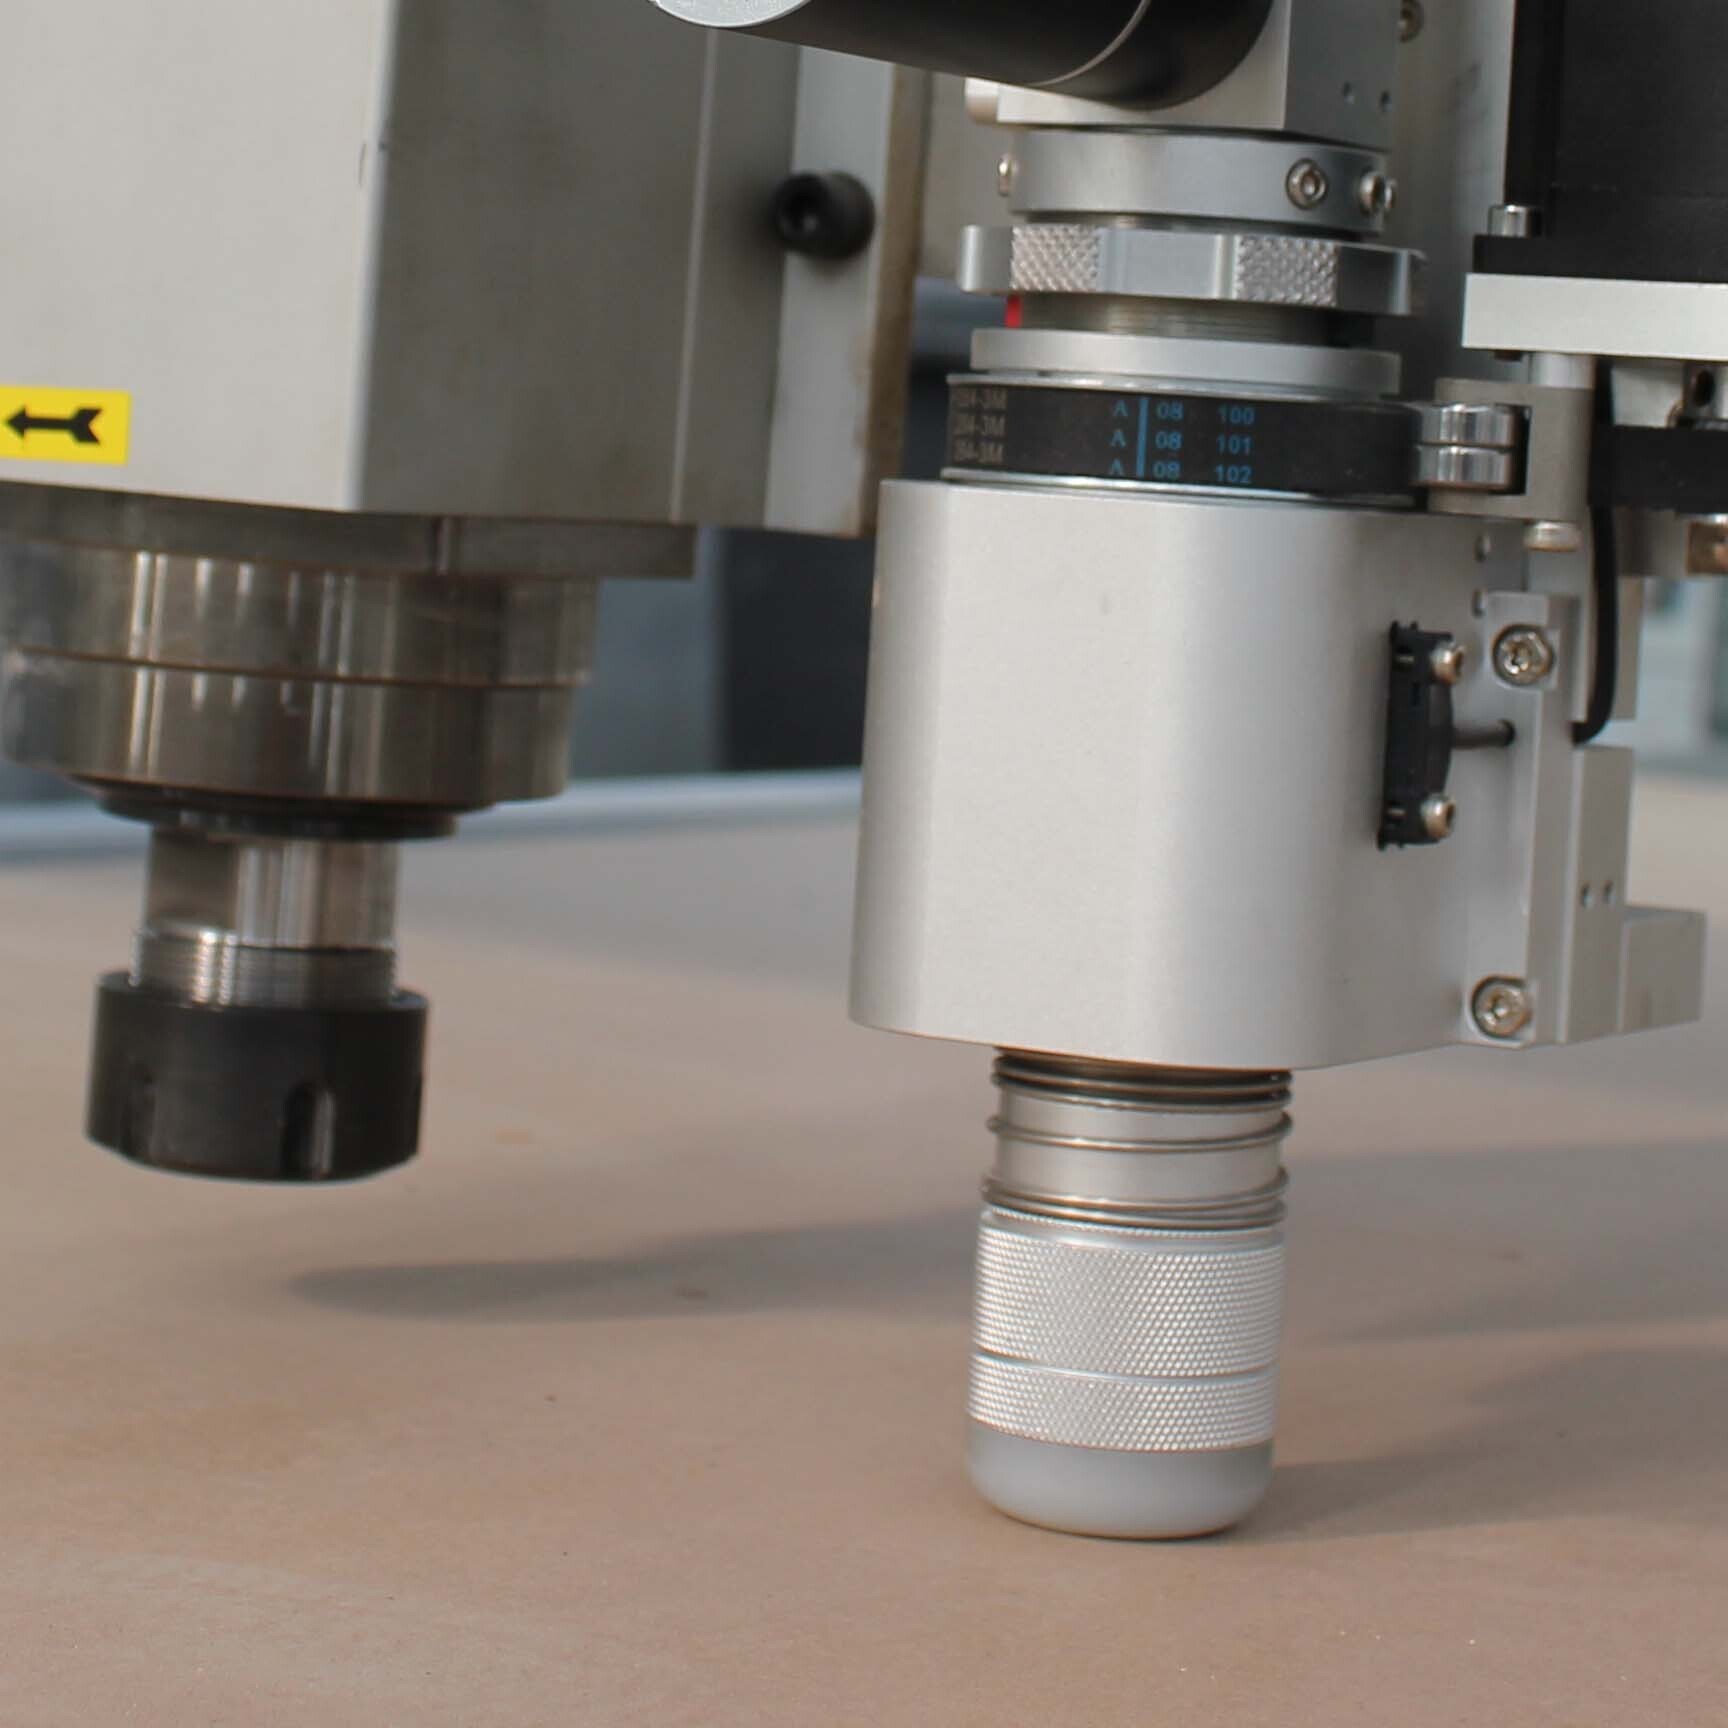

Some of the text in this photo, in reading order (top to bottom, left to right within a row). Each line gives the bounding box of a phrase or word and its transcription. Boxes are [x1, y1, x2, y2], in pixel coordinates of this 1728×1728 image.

[1156, 401, 1184, 421] 08
[1217, 404, 1255, 425] 100
[1155, 430, 1183, 451] 08
[1216, 434, 1252, 455] 101
[1153, 460, 1182, 480] 08
[1215, 464, 1252, 485] 102
